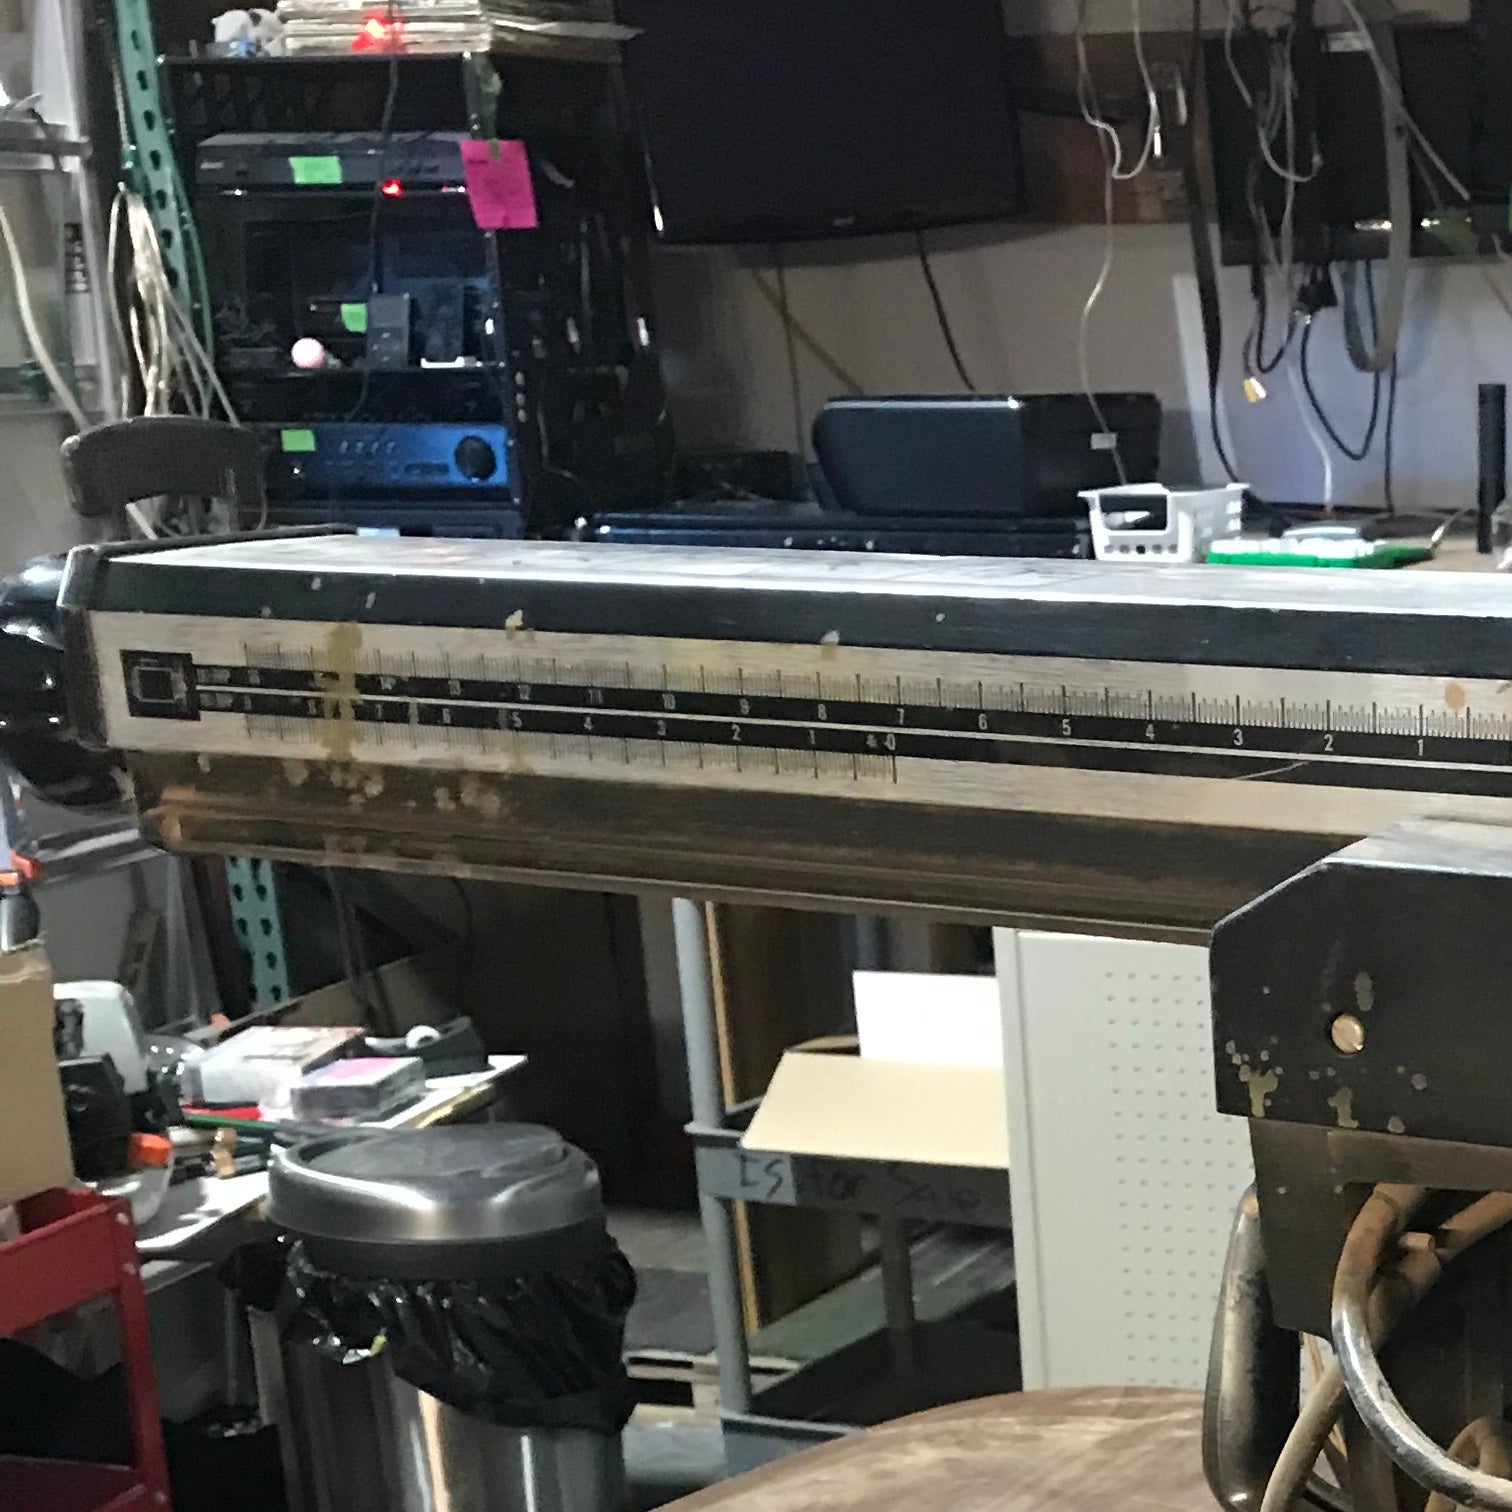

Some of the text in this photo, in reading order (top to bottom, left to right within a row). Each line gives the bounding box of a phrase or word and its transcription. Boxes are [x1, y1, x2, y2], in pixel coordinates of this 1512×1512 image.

[661, 693, 677, 711] 10
[739, 698, 751, 716] 9
[816, 703, 828, 721] 8
[896, 707, 906, 726] 7
[978, 713, 988, 731] 6
[1061, 718, 1072, 737] 5
[1145, 723, 1156, 741] 4
[1232, 728, 1244, 747] 3
[1323, 733, 1335, 752] 2
[1416, 738, 1424, 757] 1
[731, 723, 742, 741] 2
